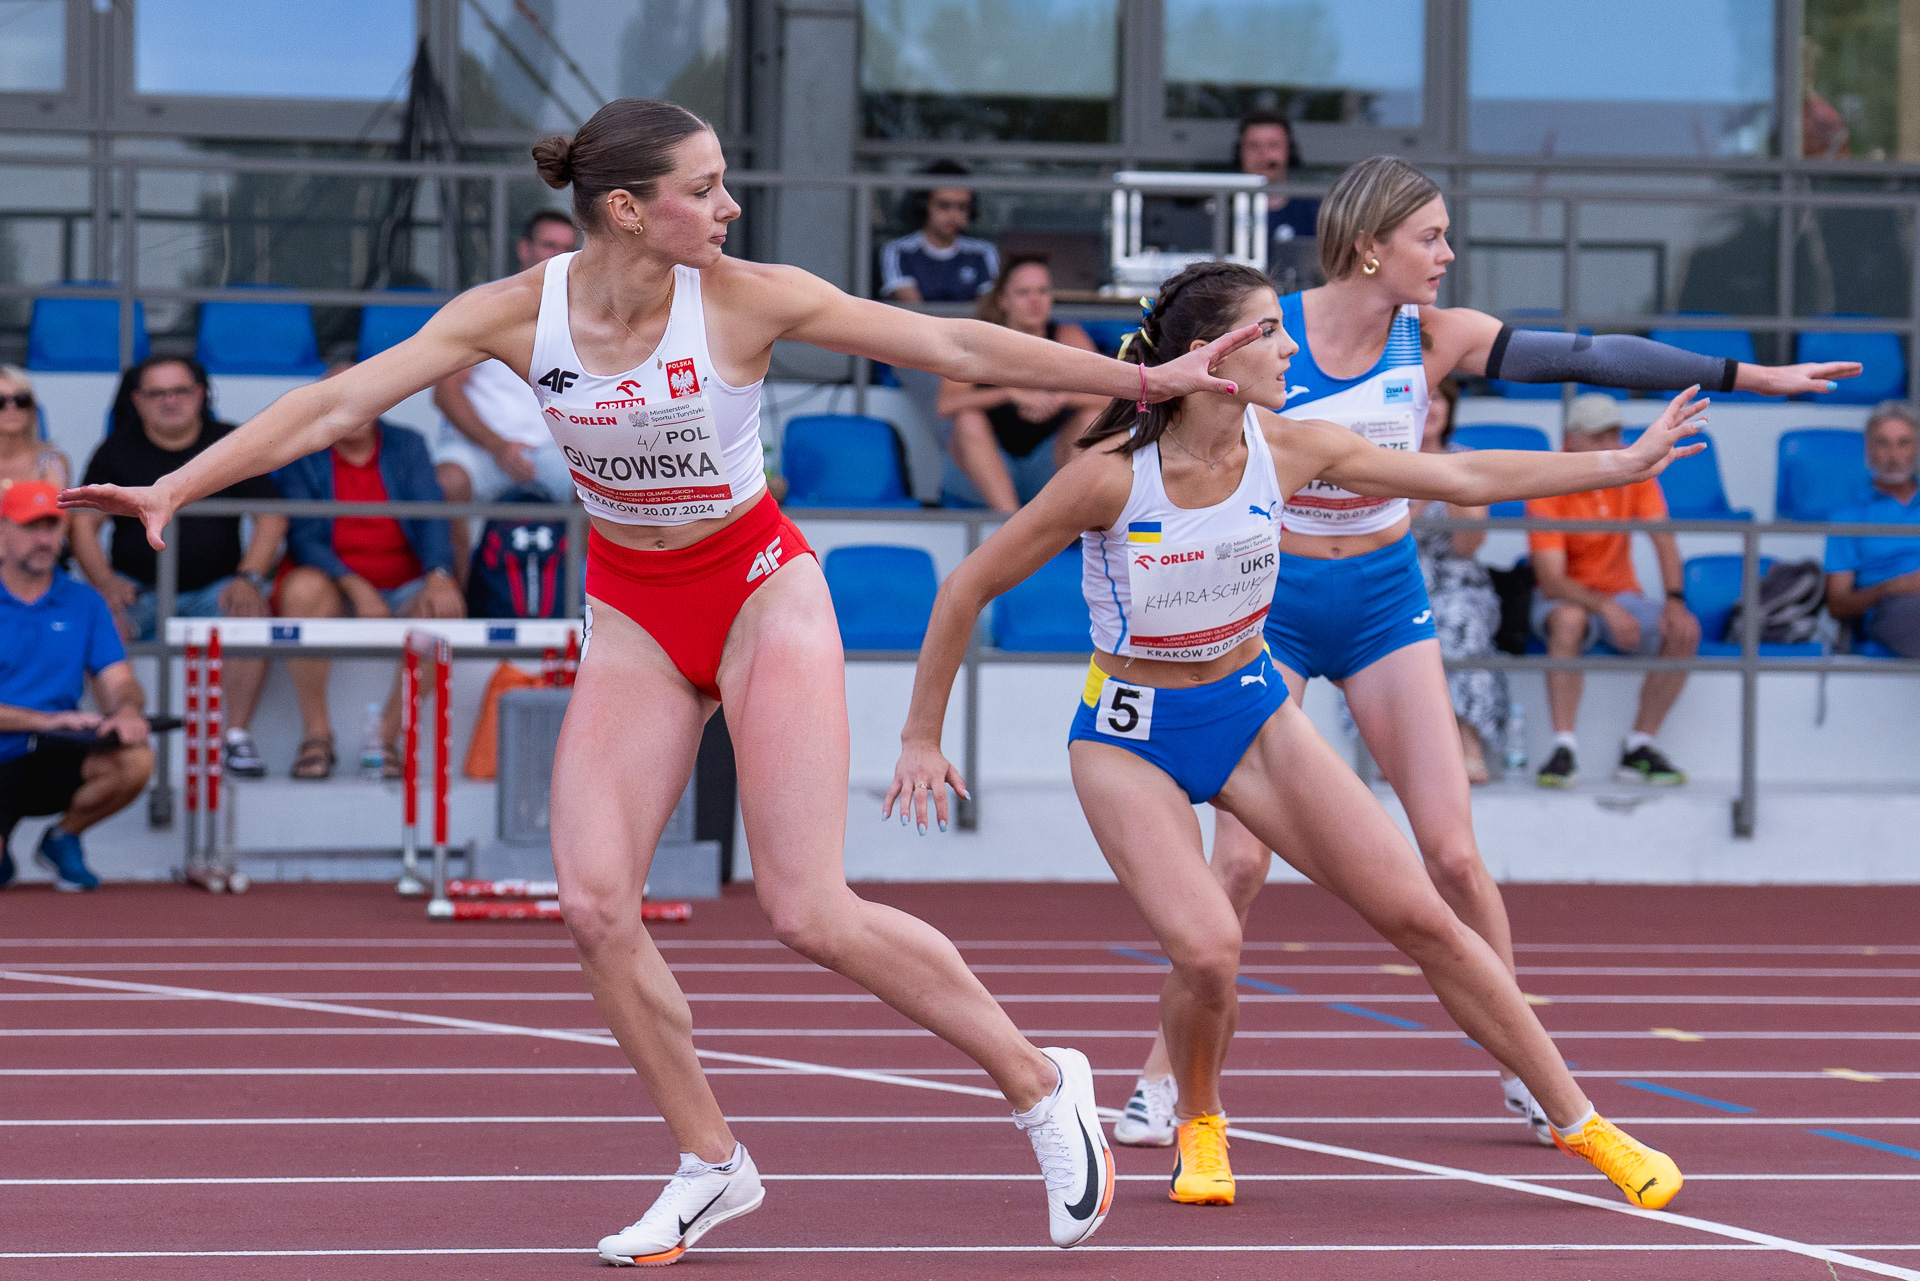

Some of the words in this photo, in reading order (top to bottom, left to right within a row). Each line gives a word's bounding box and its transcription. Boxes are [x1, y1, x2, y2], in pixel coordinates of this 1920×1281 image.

[668, 360, 692, 370] POLSKA
[538, 367, 579, 394] 4F
[599, 400, 641, 409] ORLEN
[650, 404, 689, 416] Ministerstwo
[651, 413, 671, 423] Sportu
[677, 406, 704, 418] Turystyki
[569, 415, 617, 425] ORLEN
[666, 427, 710, 444] POL
[563, 445, 719, 481] GUZOWSKA
[588, 491, 638, 514] KRAKÓW
[643, 503, 715, 517] 20.07.2024
[746, 535, 782, 582] 4F
[1160, 550, 1204, 565] ORLEN
[1241, 553, 1275, 575] UKR
[1144, 576, 1261, 613] KHARASCHUK
[1147, 648, 1203, 658] KRAKÓW
[1207, 625, 1256, 656] 20.07.2024
[1108, 687, 1140, 733] 5
